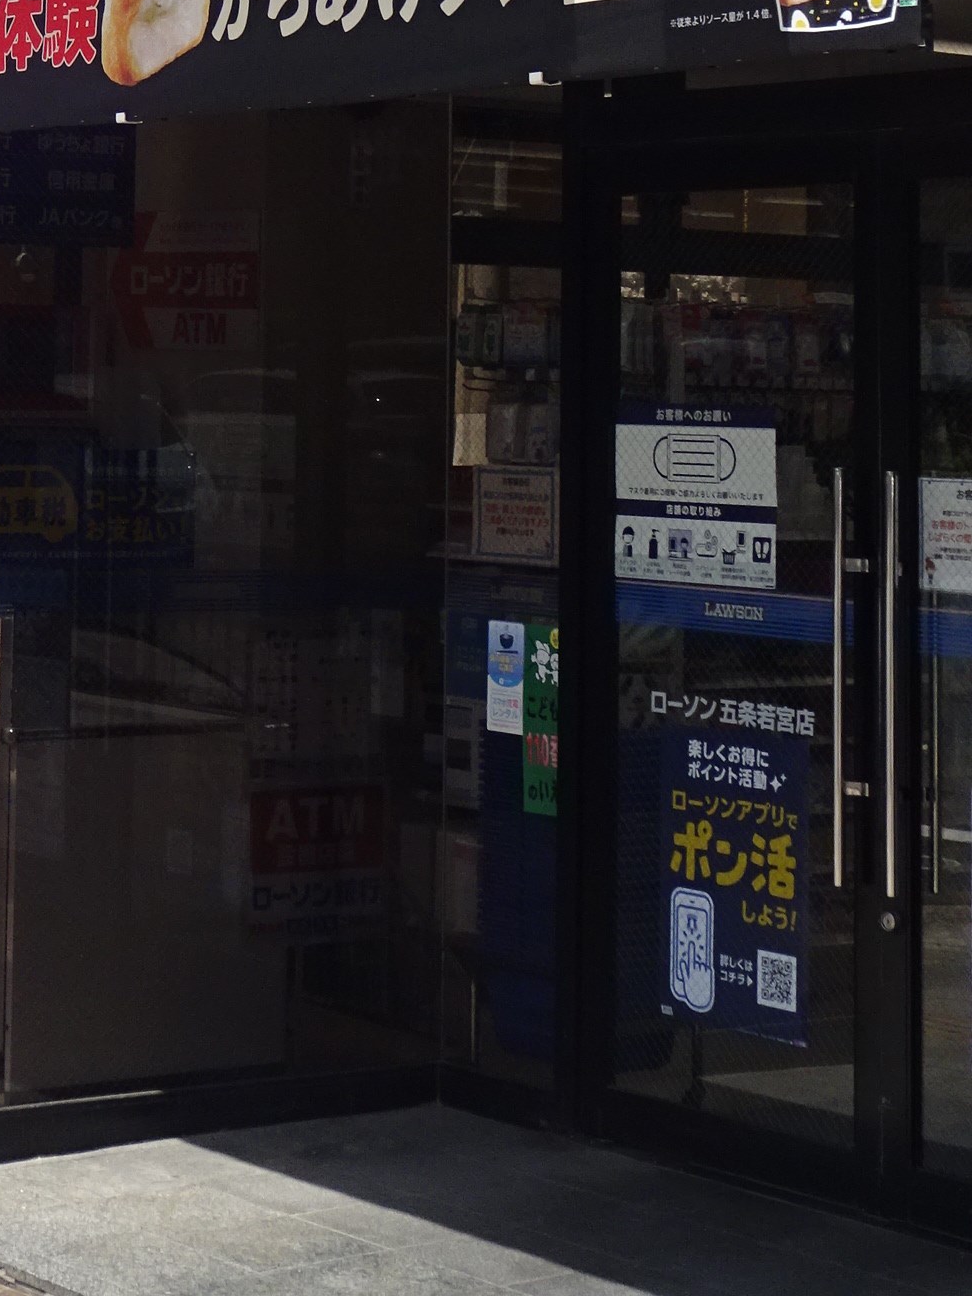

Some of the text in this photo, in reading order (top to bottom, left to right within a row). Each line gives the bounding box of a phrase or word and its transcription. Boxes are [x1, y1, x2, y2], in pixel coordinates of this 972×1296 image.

[130, 262, 250, 298] ローソン銀行
[173, 312, 227, 345] ATM
[704, 601, 764, 622] LAWSON
[650, 690, 816, 737] ローソン五条若宮店
[687, 739, 770, 768] 楽しくお得に
[687, 761, 768, 791] ポイント活動
[265, 795, 365, 841] ATM
[671, 789, 798, 831] ローソンアプリで
[670, 819, 797, 901] ポン活
[720, 969, 746, 986] コチラ
